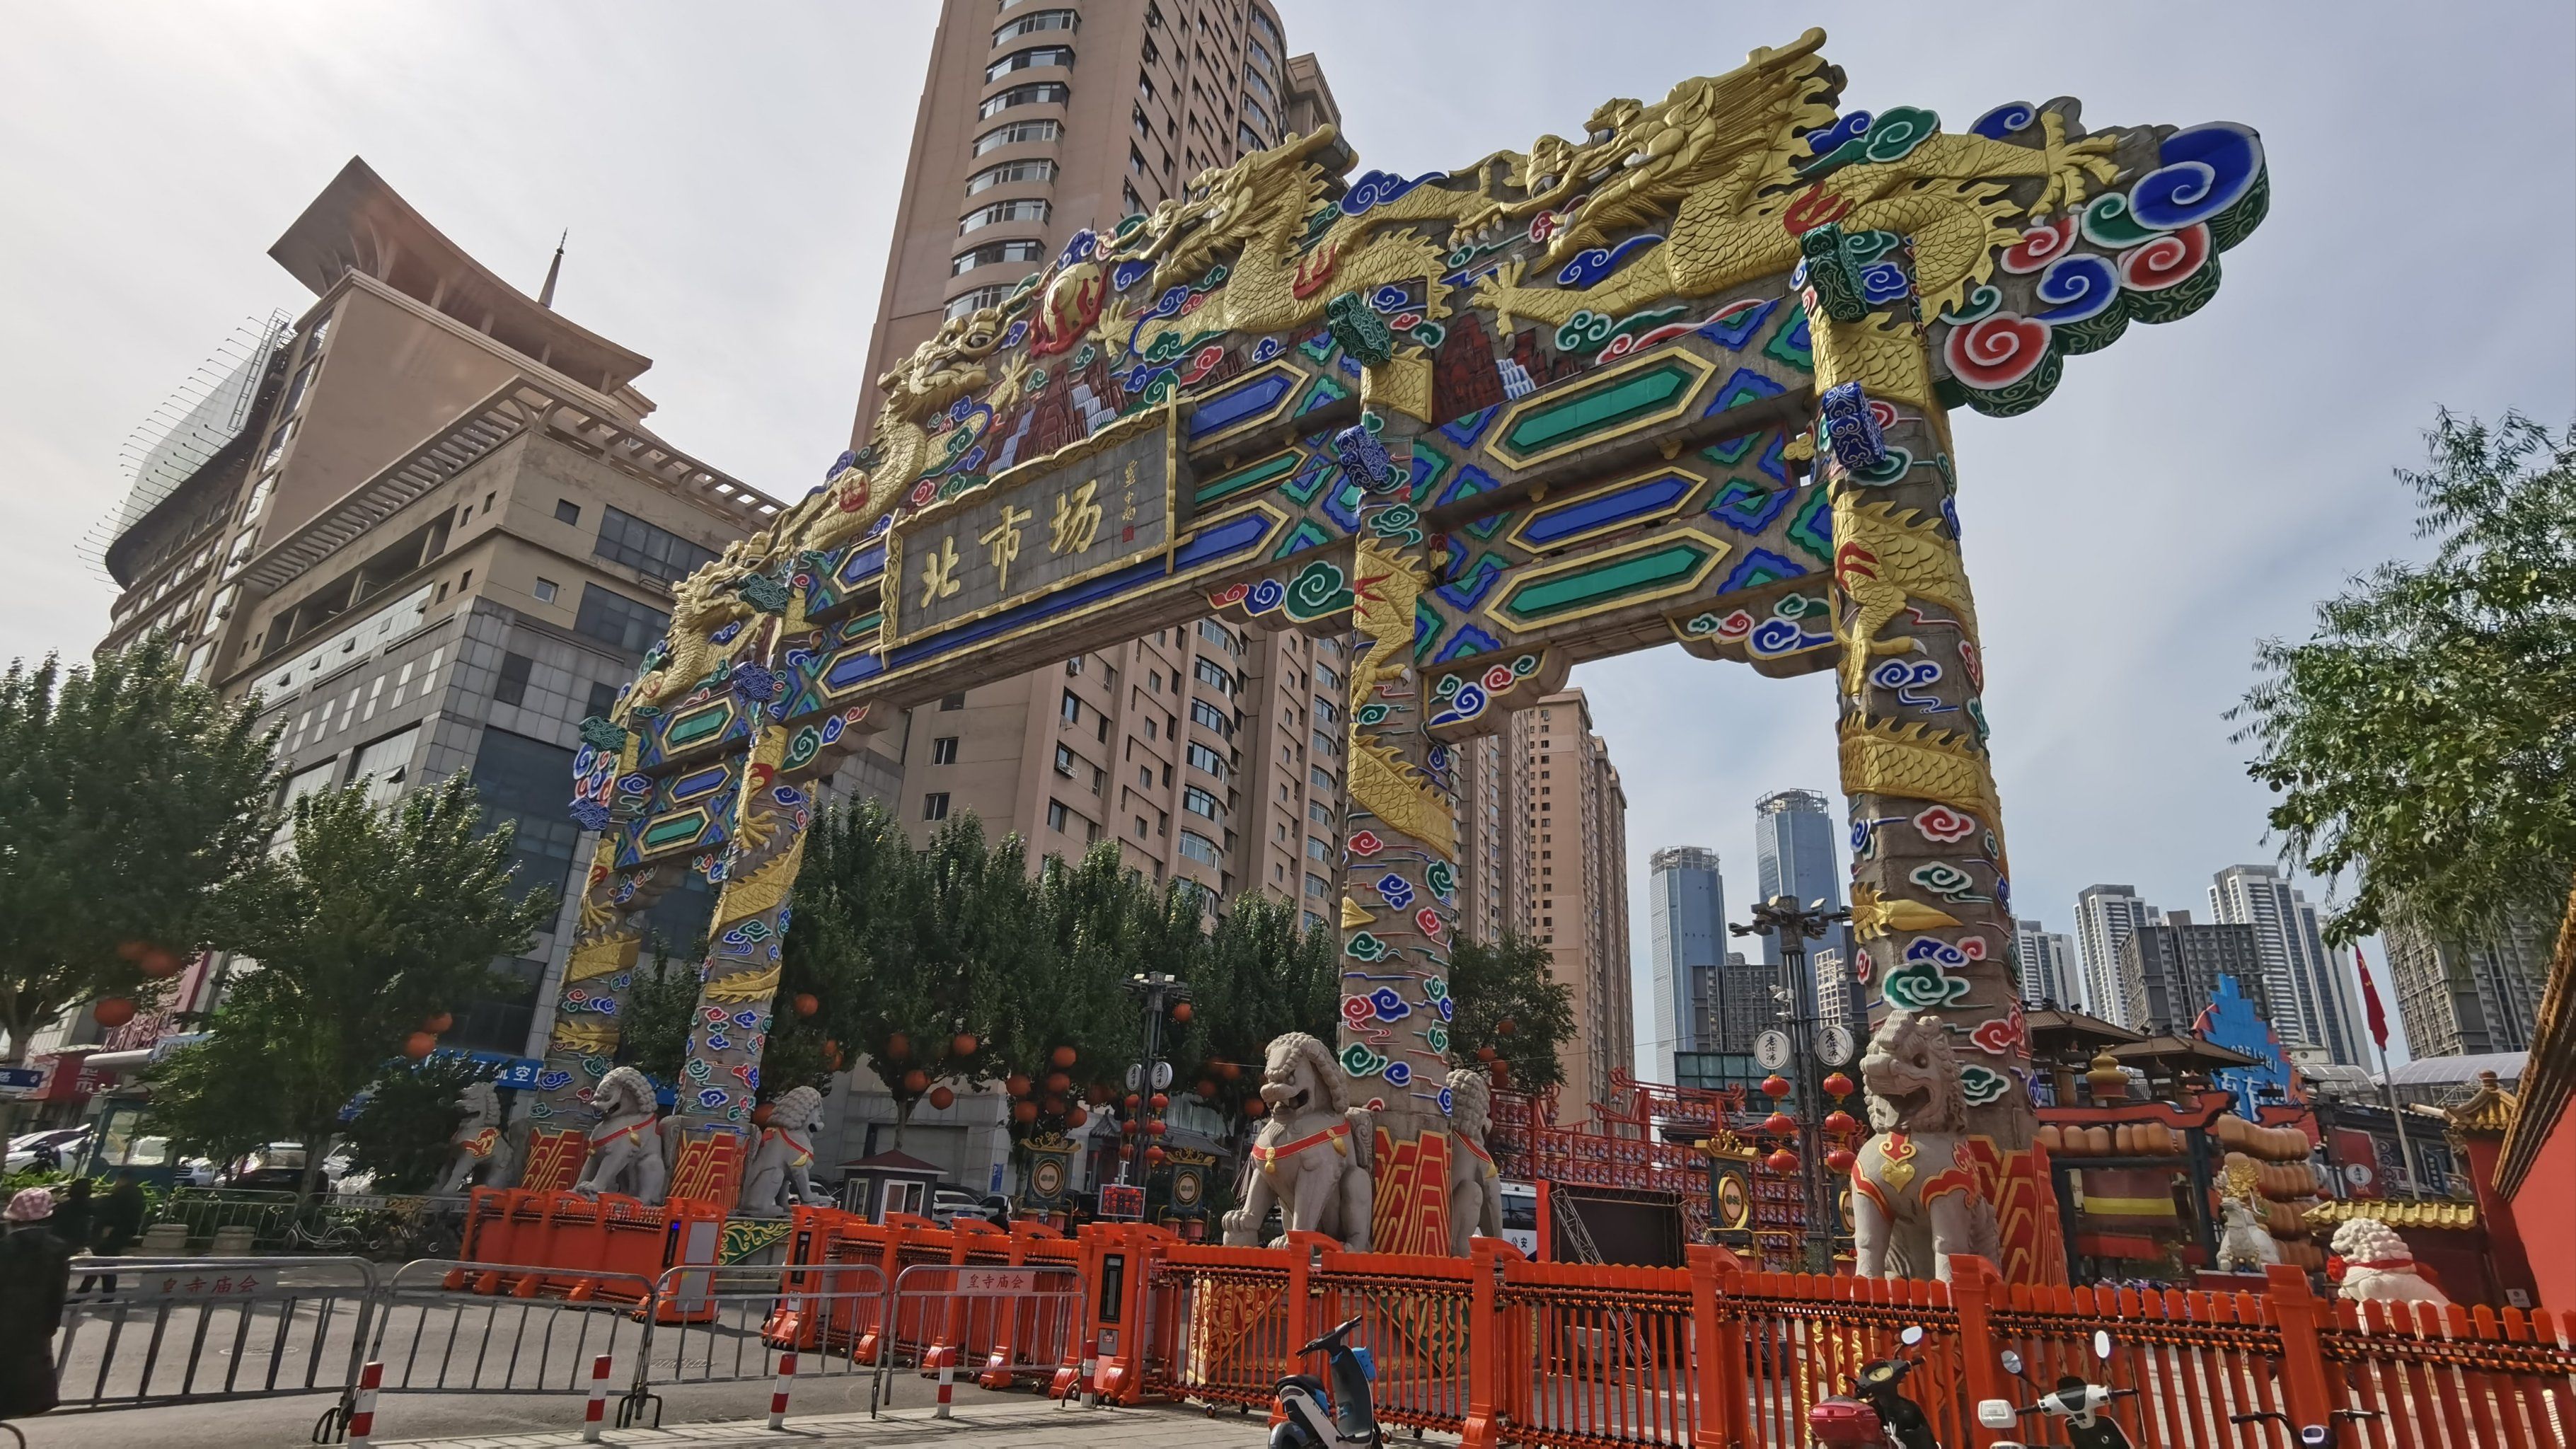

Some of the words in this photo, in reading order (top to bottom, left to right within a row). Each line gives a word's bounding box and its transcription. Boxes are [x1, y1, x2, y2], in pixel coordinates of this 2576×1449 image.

[920, 479, 1102, 609] 北市场
[1511, 1236, 1527, 1248] 公安
[160, 1275, 260, 1294] 皇寺庙会
[966, 1274, 1024, 1288] 皇寺庙会
